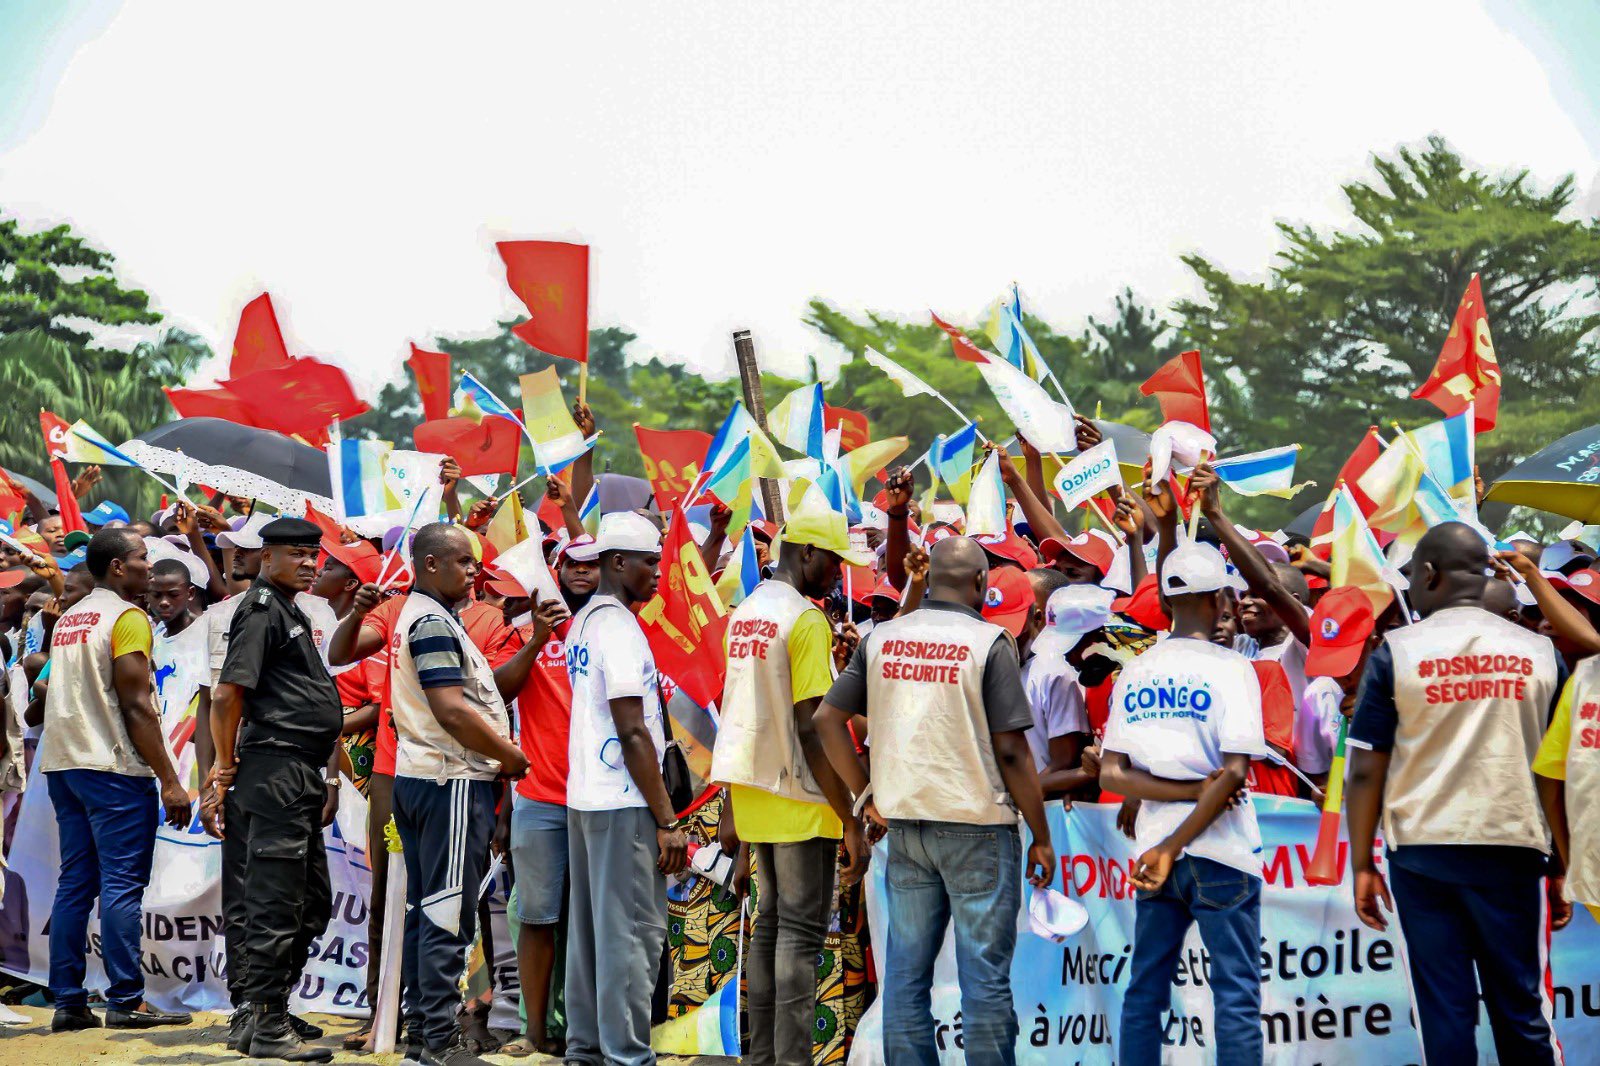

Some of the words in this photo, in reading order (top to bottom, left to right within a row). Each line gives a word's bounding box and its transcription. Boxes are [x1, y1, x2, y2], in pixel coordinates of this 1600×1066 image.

[881, 639, 970, 662] #DSN2026
[882, 660, 960, 685] SÉCURITÉ
[1418, 654, 1534, 679] #DSN2026
[1124, 686, 1212, 713] CONGO
[1425, 677, 1527, 705] SÉCURITÉ
[142, 912, 225, 942] IDEN
[1061, 944, 1132, 986] Merci
[1171, 948, 1210, 987] ett
[1260, 928, 1394, 984] étoile
[1030, 1002, 1050, 1047] à
[1160, 1008, 1206, 1048] tre
